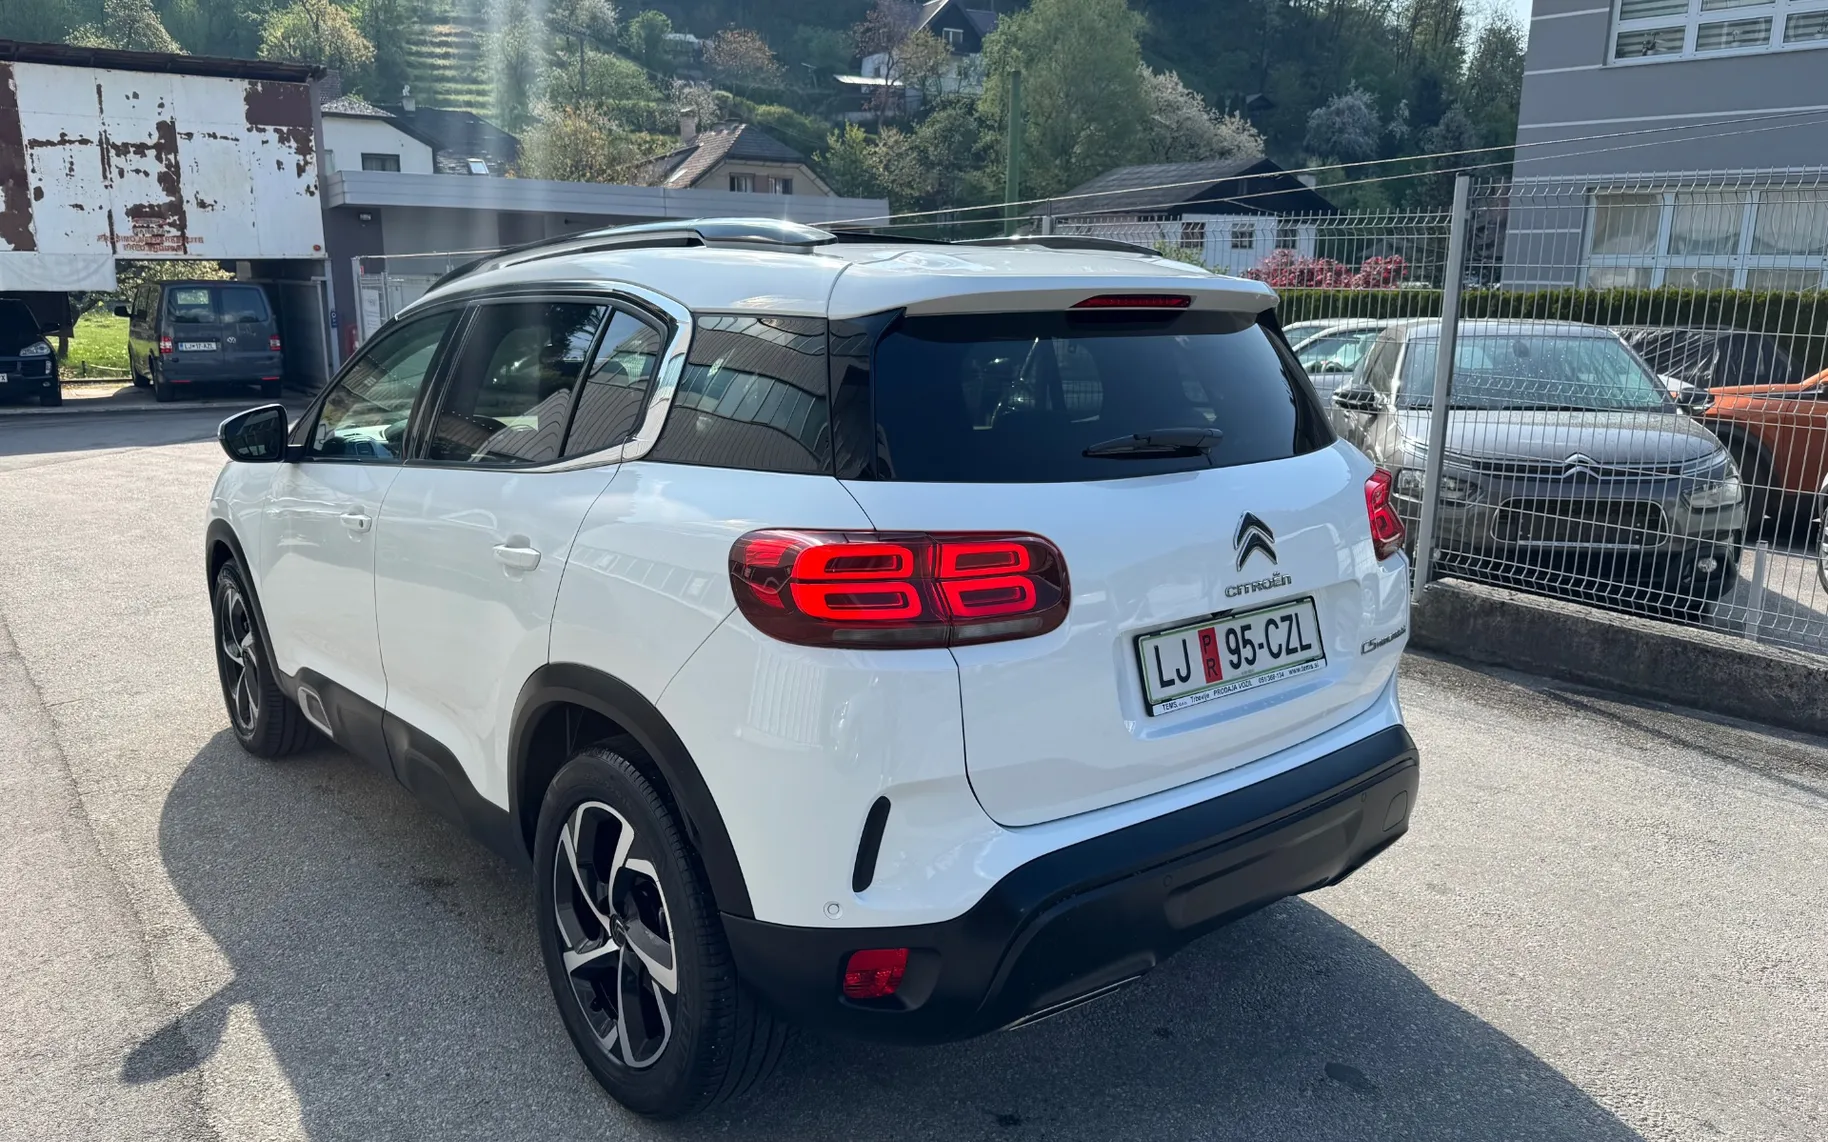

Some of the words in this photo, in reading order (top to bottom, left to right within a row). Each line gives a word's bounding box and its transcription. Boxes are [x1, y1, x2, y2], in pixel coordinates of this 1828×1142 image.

[1154, 638, 1191, 688] LJ
[1225, 612, 1312, 670] 95-CZL
[1213, 684, 1238, 697] PRODAJA
